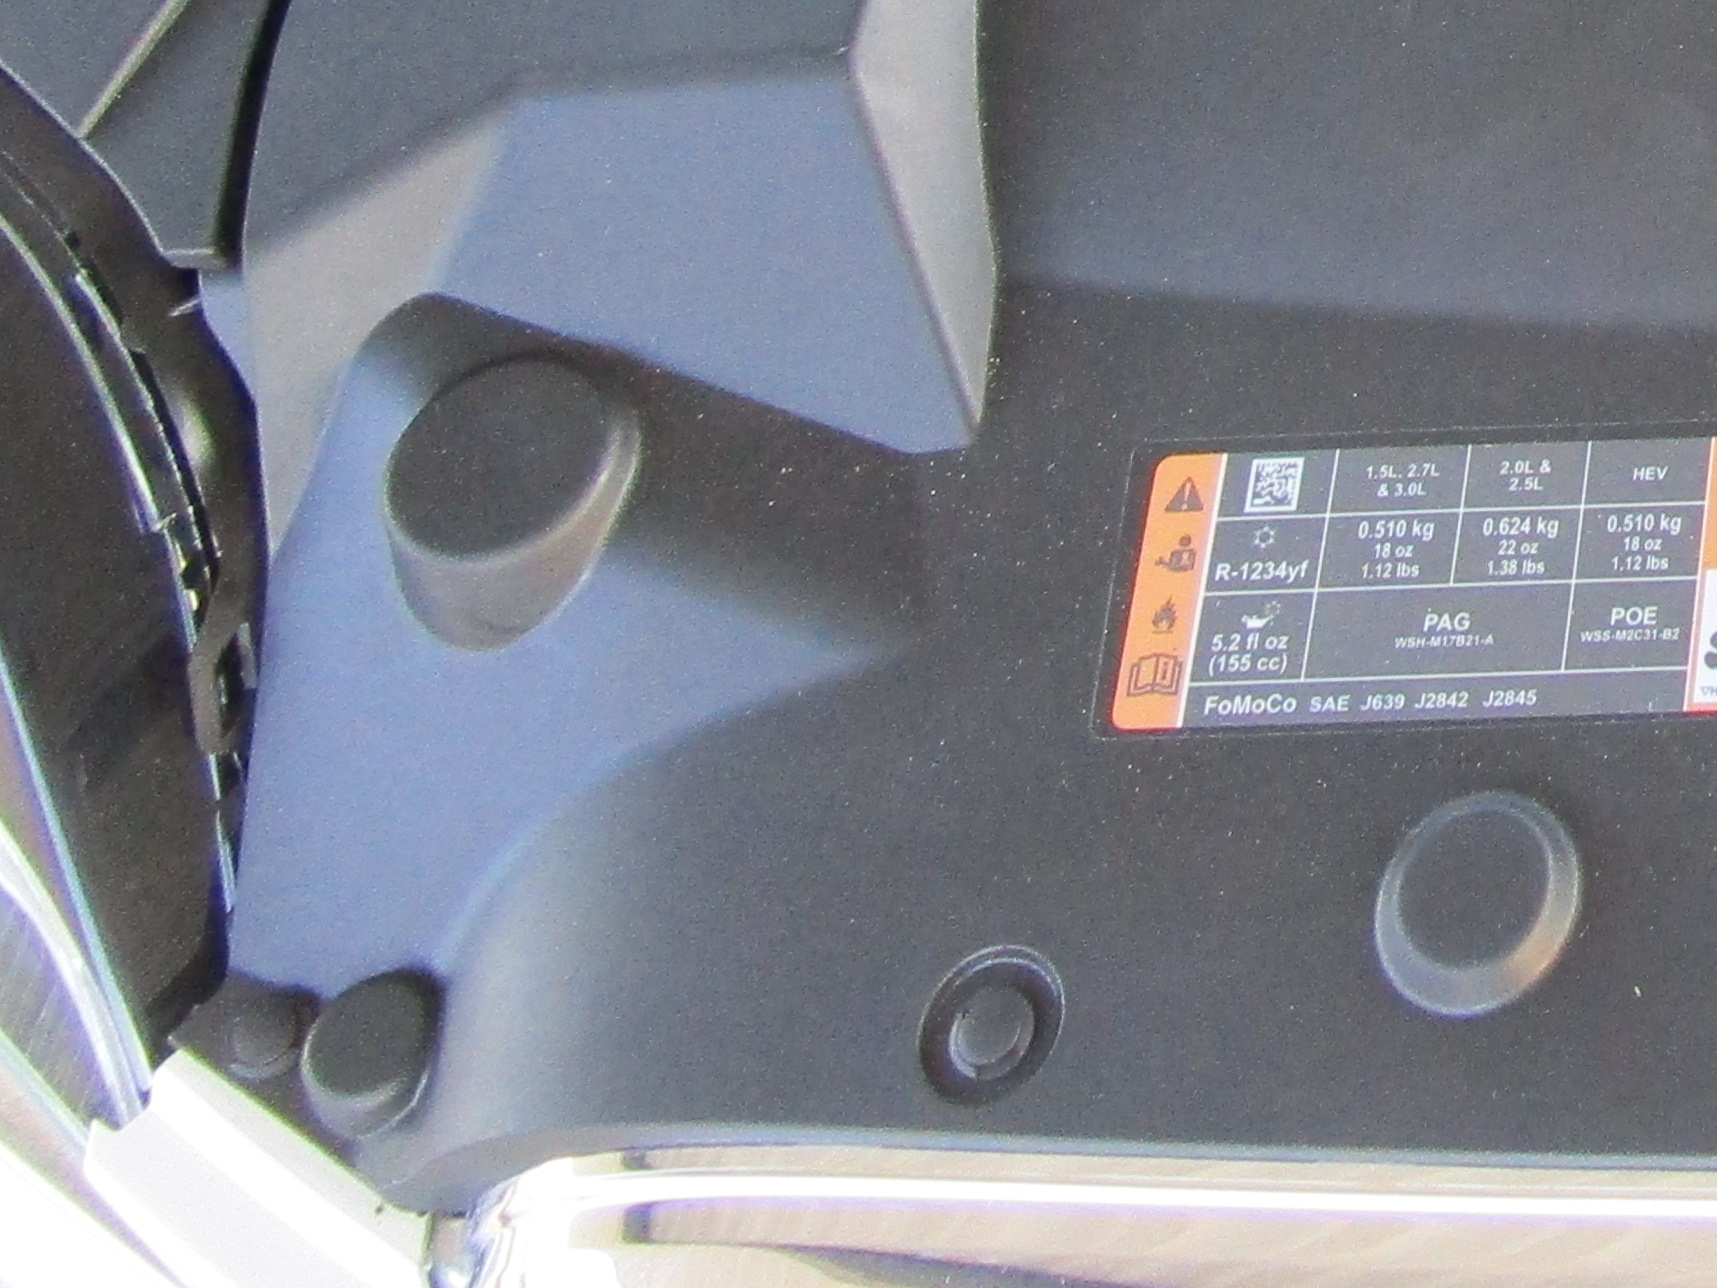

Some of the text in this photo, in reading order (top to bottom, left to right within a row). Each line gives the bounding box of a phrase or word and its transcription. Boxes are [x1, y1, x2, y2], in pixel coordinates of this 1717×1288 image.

[1407, 463, 1440, 477] 2.7L
[1500, 459, 1551, 475] 2.0L &
[1633, 466, 1669, 481] HEV
[1377, 482, 1427, 497] & 3.0L
[1508, 477, 1543, 491] 2.5L
[1358, 519, 1435, 541] 0.510 kg
[1483, 516, 1559, 539] 0.624 kg
[1607, 513, 1682, 535] 0.510 kg
[1374, 545, 1414, 558] 18 oz
[1498, 540, 1539, 556] 22 oz
[1623, 537, 1662, 552] 18 oz
[1361, 563, 1420, 579] 1.12 lbs
[1488, 559, 1545, 576] 1.38 lbs
[1612, 555, 1669, 571] 1.12 lbs
[1214, 559, 1310, 584] R-1234yf
[1423, 612, 1471, 632] PAG
[1610, 606, 1658, 625] POE
[1211, 632, 1288, 652] 5.2 fl oz
[1394, 634, 1494, 649] WSH-M17B21-A
[1580, 628, 1680, 643] WSS-M2C31-B2
[1208, 652, 1288, 677] (155 cc)
[1204, 689, 1537, 716] FoMoCo SAE J639 J2842 J2845
